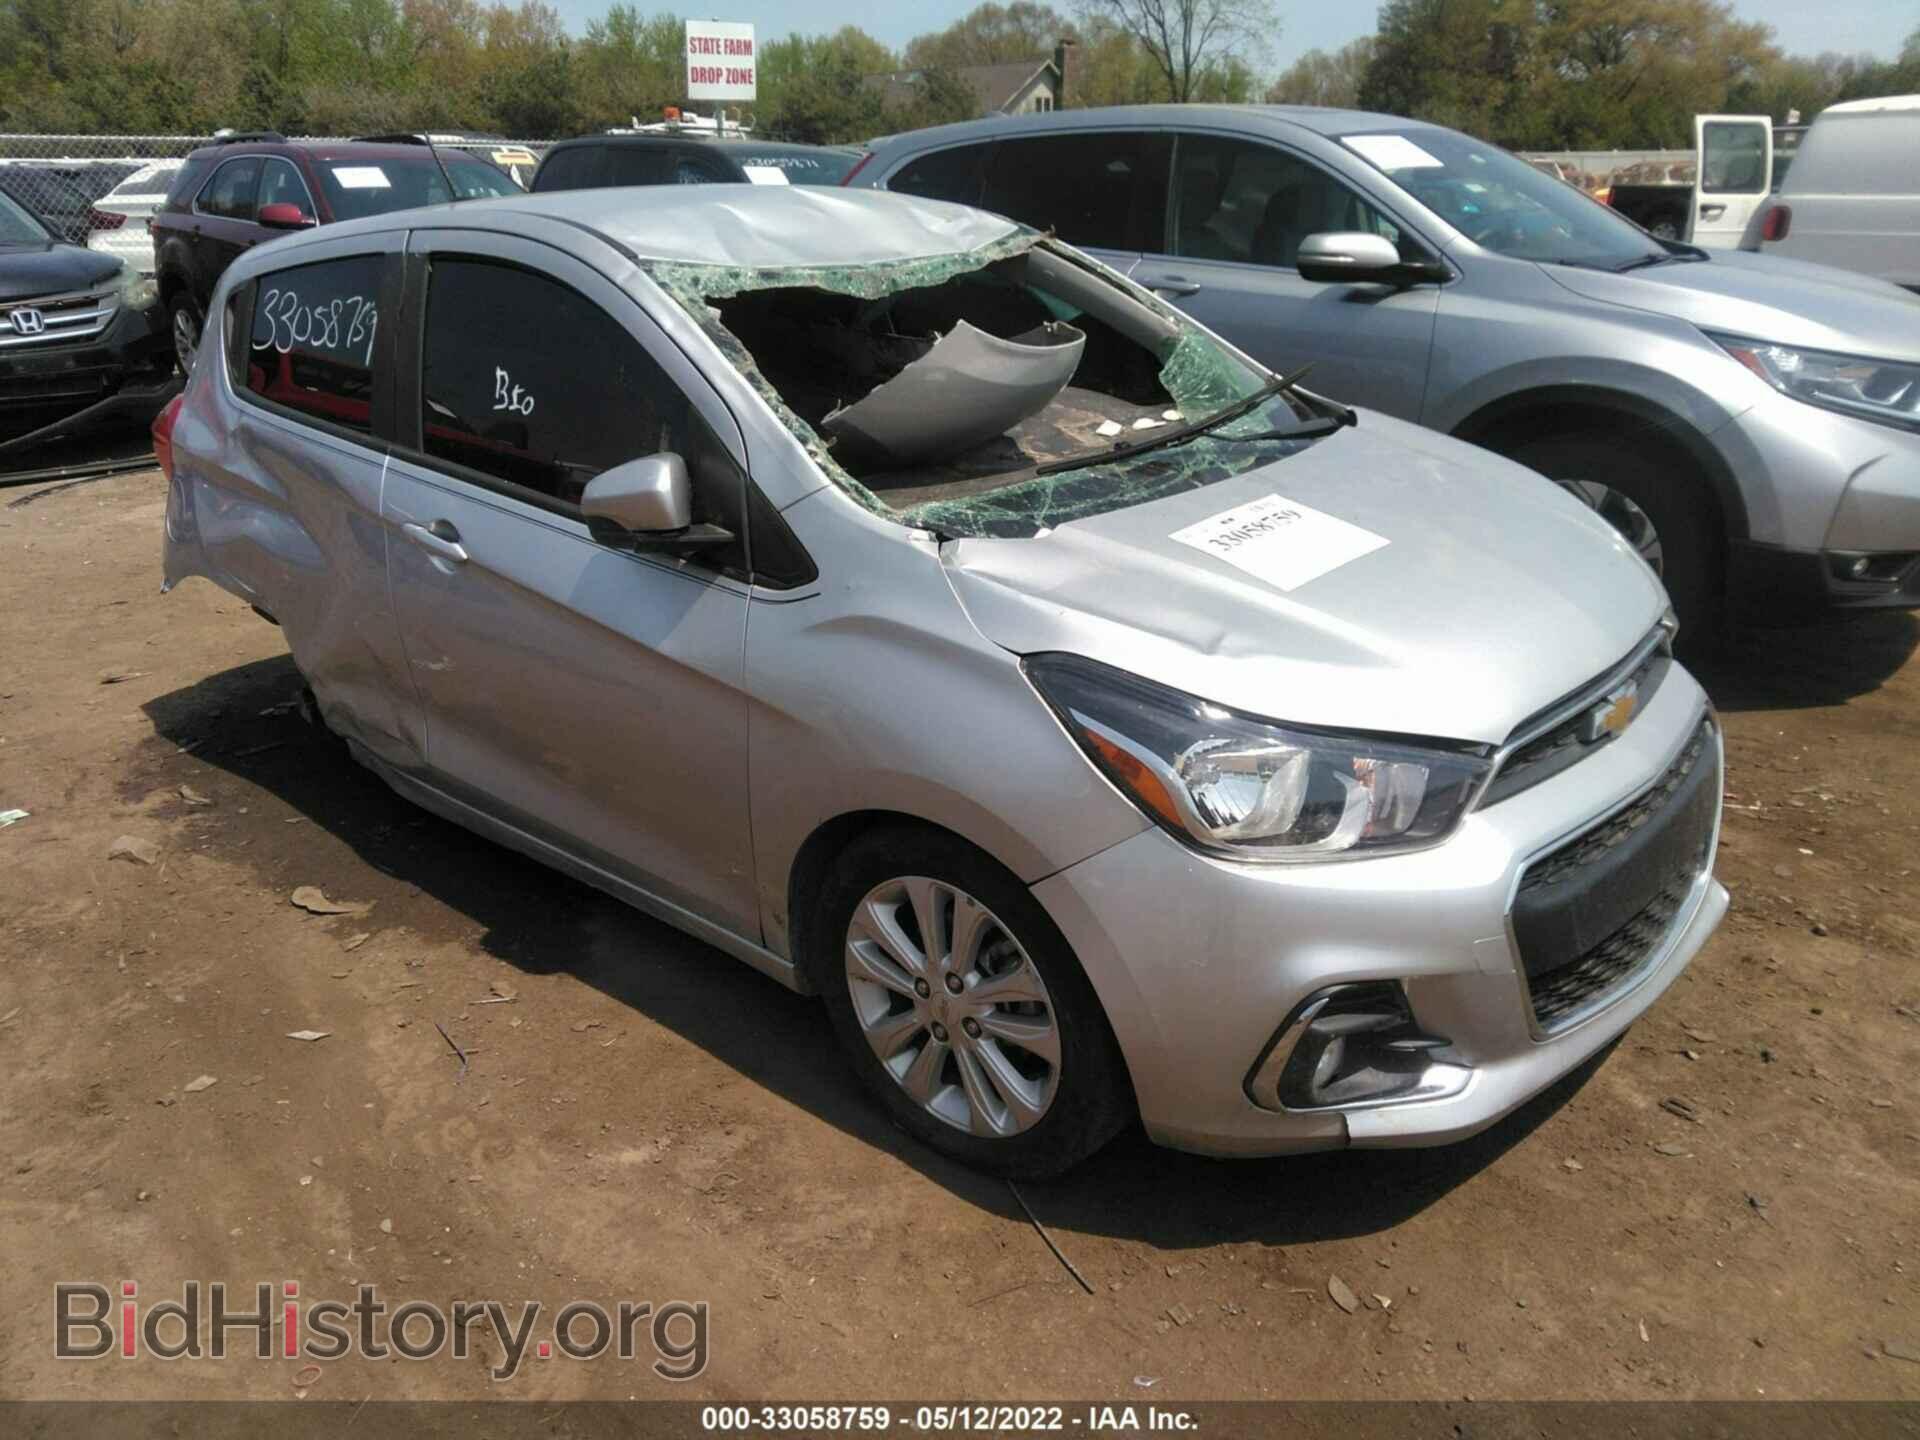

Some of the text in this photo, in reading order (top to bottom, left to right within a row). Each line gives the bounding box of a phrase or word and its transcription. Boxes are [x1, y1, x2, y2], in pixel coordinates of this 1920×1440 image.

[689, 37, 753, 56] STATE FARM
[690, 66, 754, 85] DROP ZONE
[252, 289, 378, 367] 33058759
